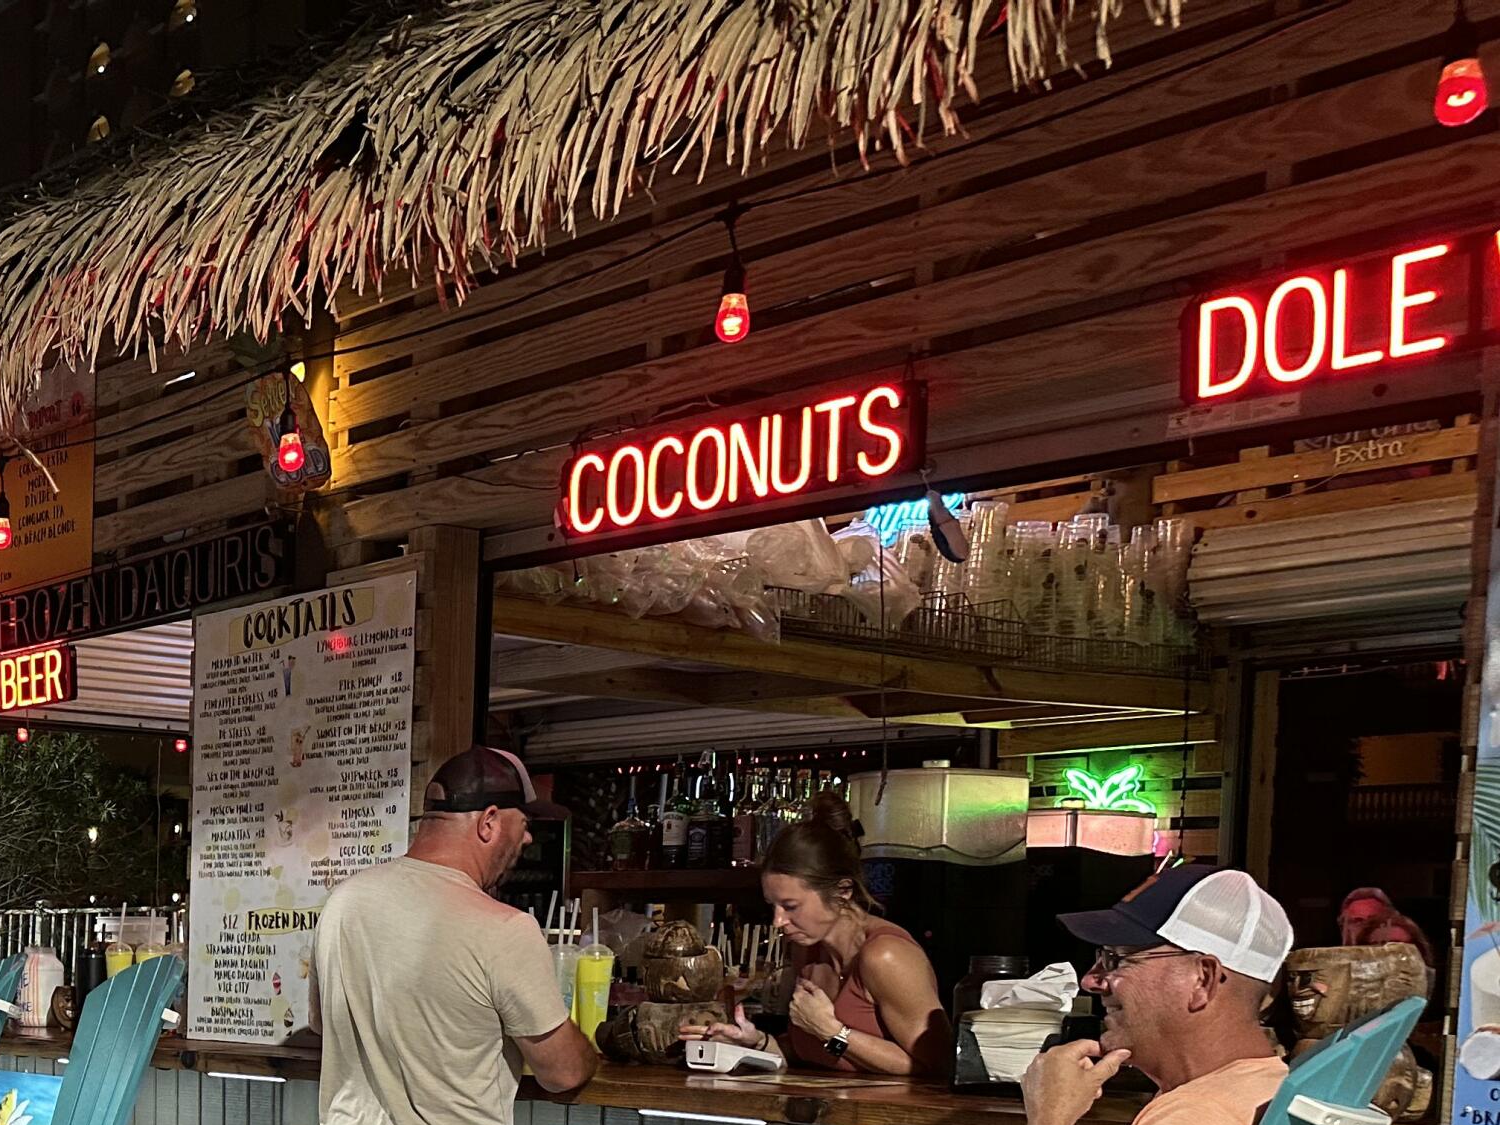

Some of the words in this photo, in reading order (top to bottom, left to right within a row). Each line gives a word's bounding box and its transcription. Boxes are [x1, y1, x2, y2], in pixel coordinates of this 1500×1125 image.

[1195, 243, 1450, 398] DOLE
[569, 385, 903, 534] COCONUTS
[1334, 438, 1405, 467] Extra
[117, 525, 276, 622] DAIQUIRIS
[243, 588, 356, 649] COCKTAILS
[360, 627, 399, 646] LEMONADE
[211, 656, 240, 670] MERMAID
[242, 652, 263, 665] WATER
[1, 649, 63, 710] BEER
[358, 675, 382, 689] PUNCH
[204, 695, 235, 710] PINEAPPLE
[237, 692, 264, 706] EXPRESS
[316, 726, 341, 739] SUNSET
[369, 721, 391, 734] BEACH
[340, 769, 382, 783] SHIPWRECK
[210, 804, 235, 817] MOSCOW
[341, 806, 375, 820] MIMOSAS
[211, 829, 251, 842] MARGARITAS
[340, 846, 355, 857] COCO
[357, 844, 375, 856] LOCO
[222, 914, 238, 930] $12
[248, 911, 289, 930] FROZEN
[292, 911, 321, 931] DRIN
[206, 944, 245, 956] STRAWBERRY
[214, 959, 238, 969] BANANA
[214, 970, 235, 980] MANGO
[218, 982, 232, 993] VICE
[235, 982, 249, 994] CITY
[211, 1006, 254, 1018] BUSHWACKER
